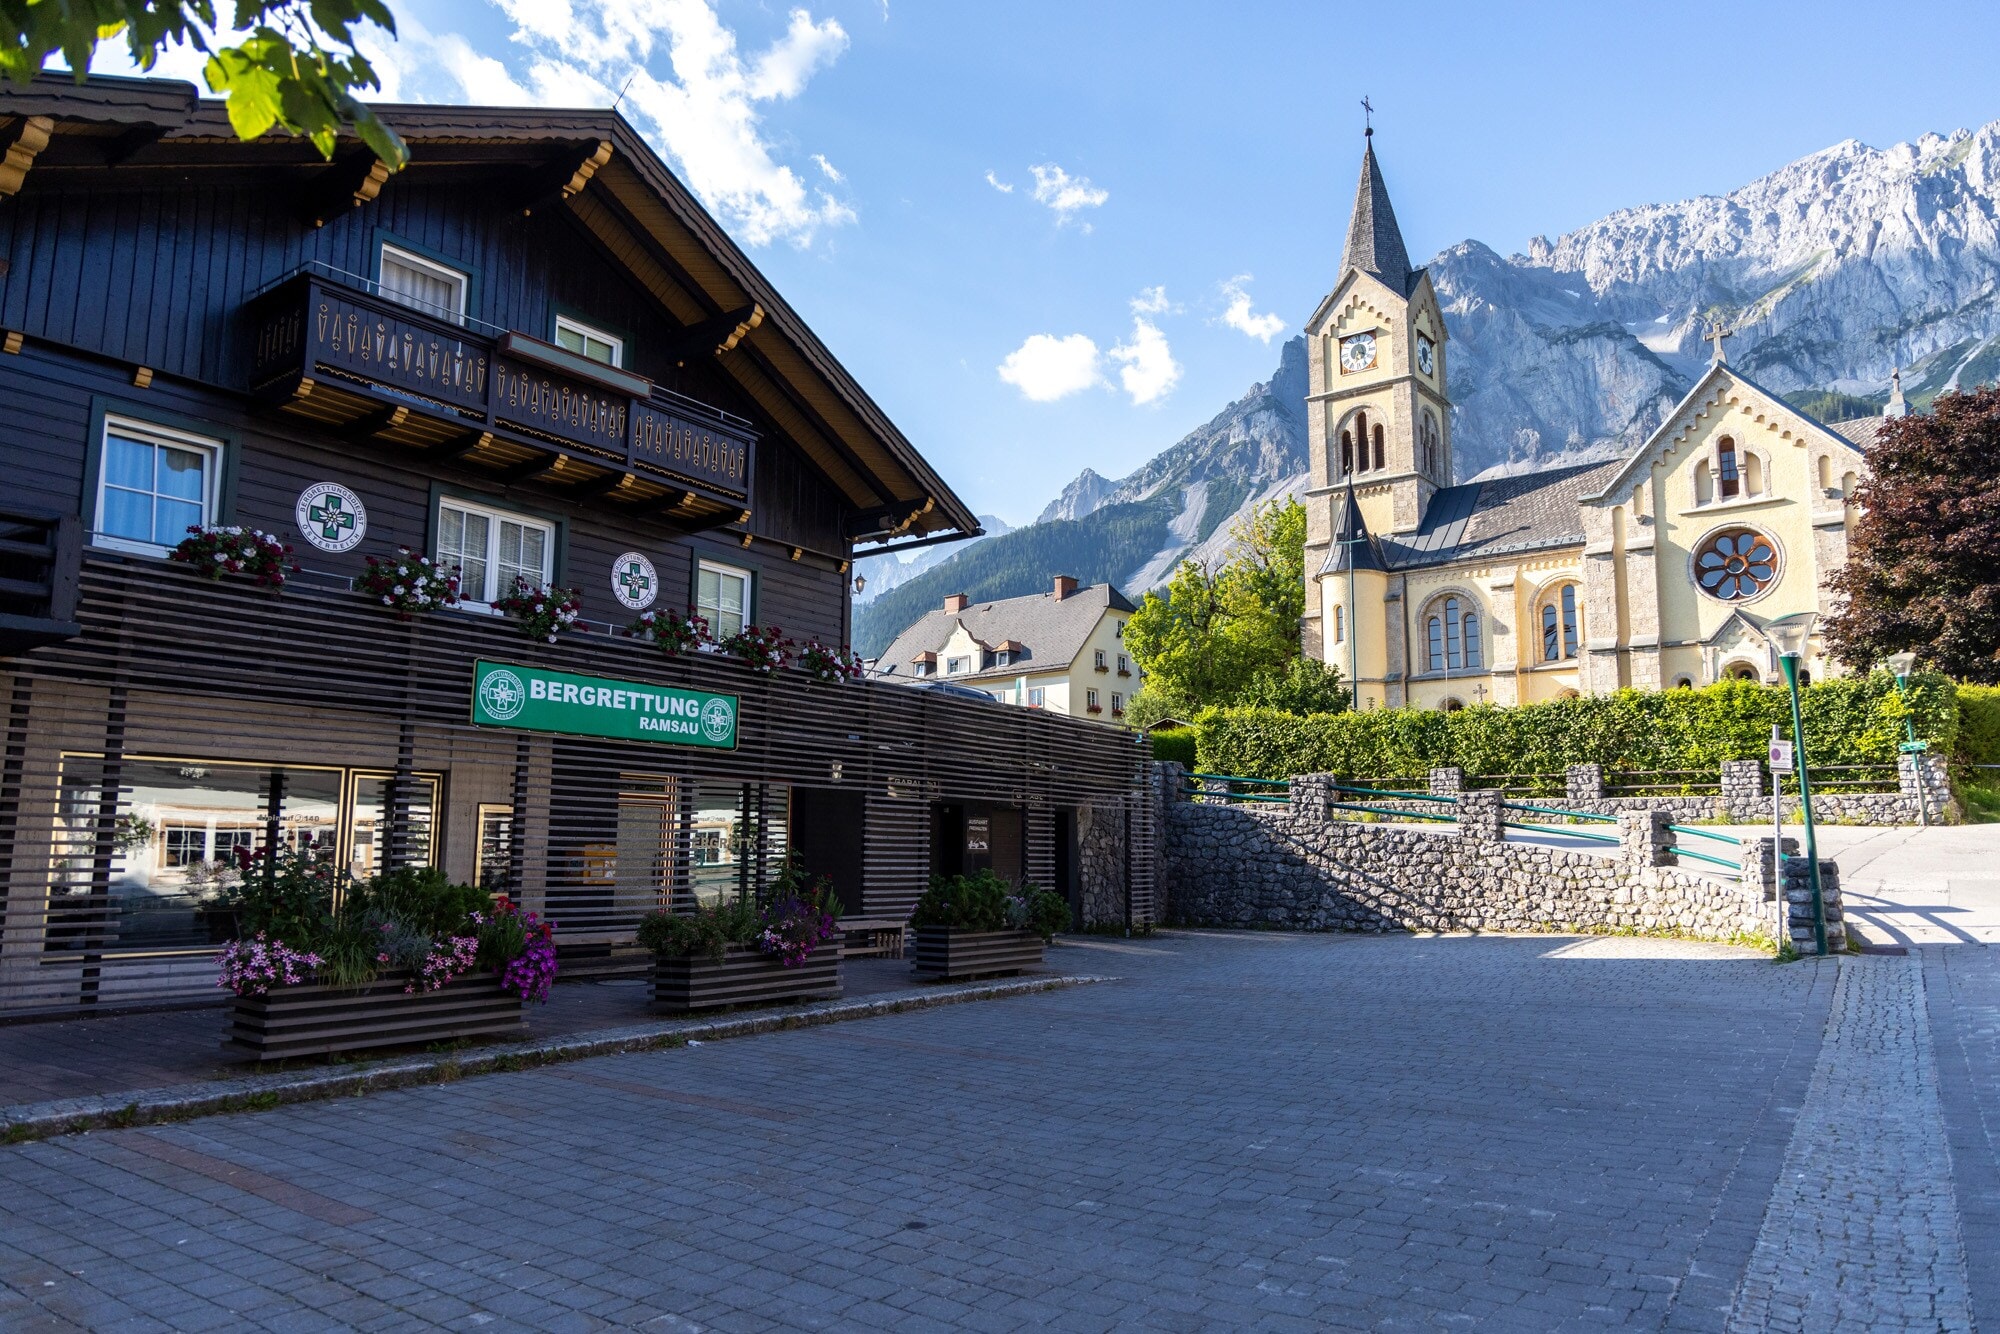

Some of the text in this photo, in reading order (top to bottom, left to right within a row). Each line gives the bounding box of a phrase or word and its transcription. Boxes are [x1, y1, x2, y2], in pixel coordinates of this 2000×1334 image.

[299, 485, 364, 525] BERGRETTUNGSDIENST
[530, 679, 700, 718] BERGRETTUNG
[639, 717, 699, 735] RAMSAU
